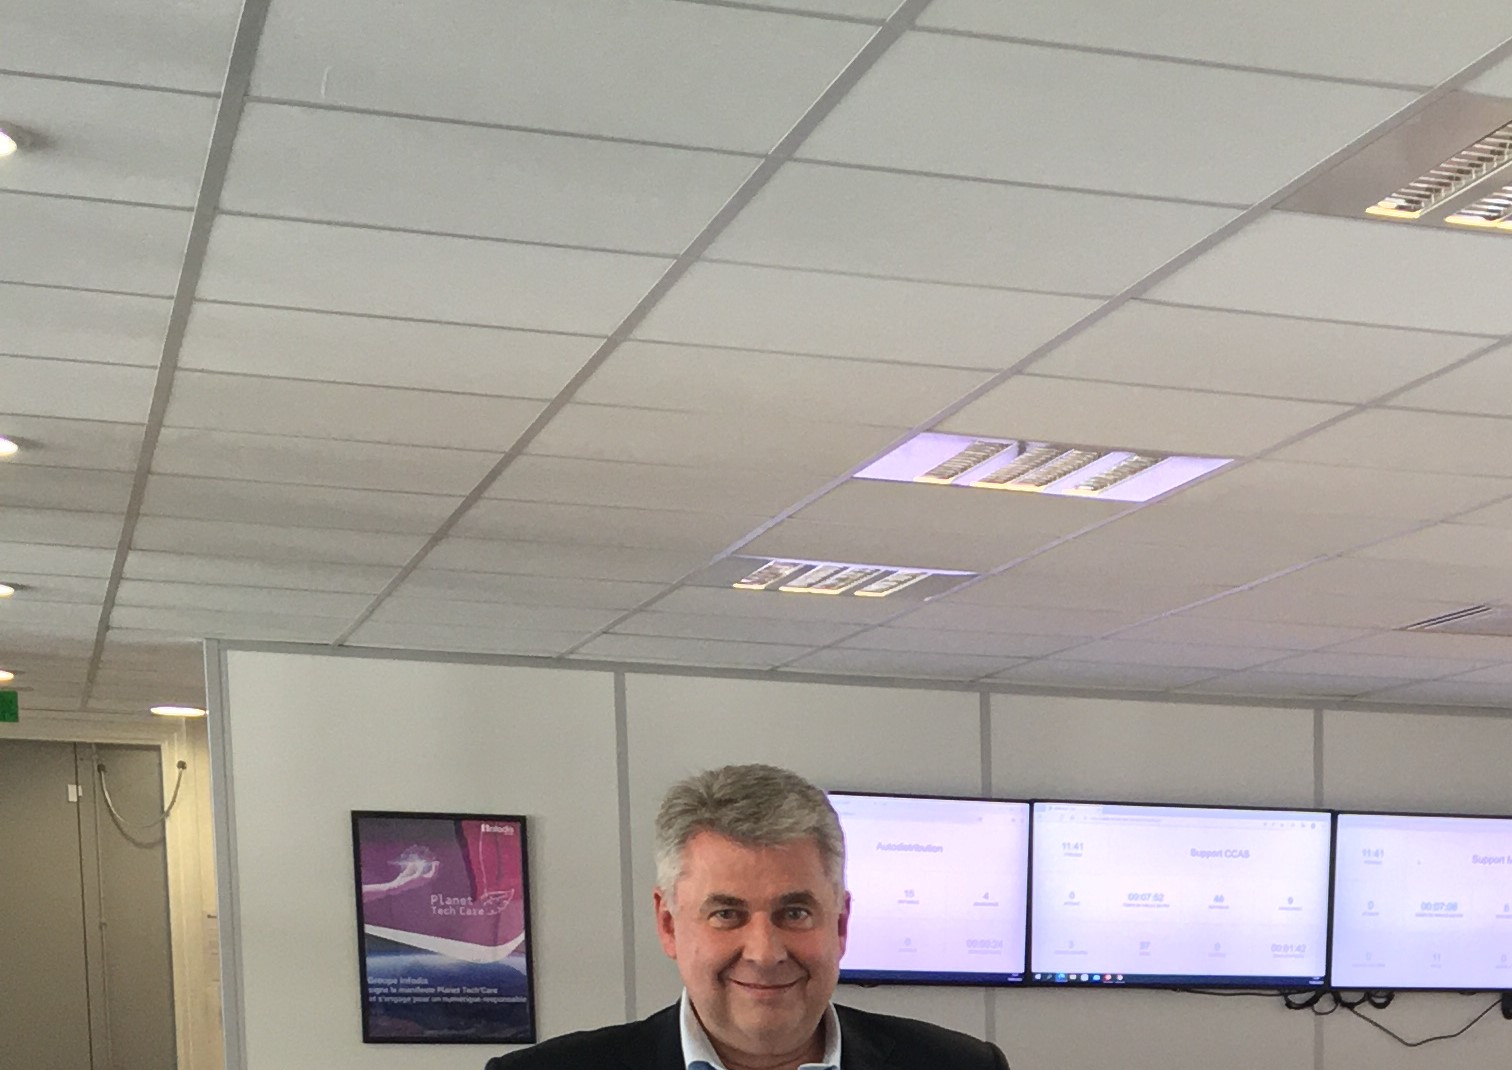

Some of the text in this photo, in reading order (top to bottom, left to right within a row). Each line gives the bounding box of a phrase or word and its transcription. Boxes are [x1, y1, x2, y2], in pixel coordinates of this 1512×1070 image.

[1190, 847, 1223, 860] Support
[1471, 854, 1506, 867] Support
[430, 893, 473, 906] Planet
